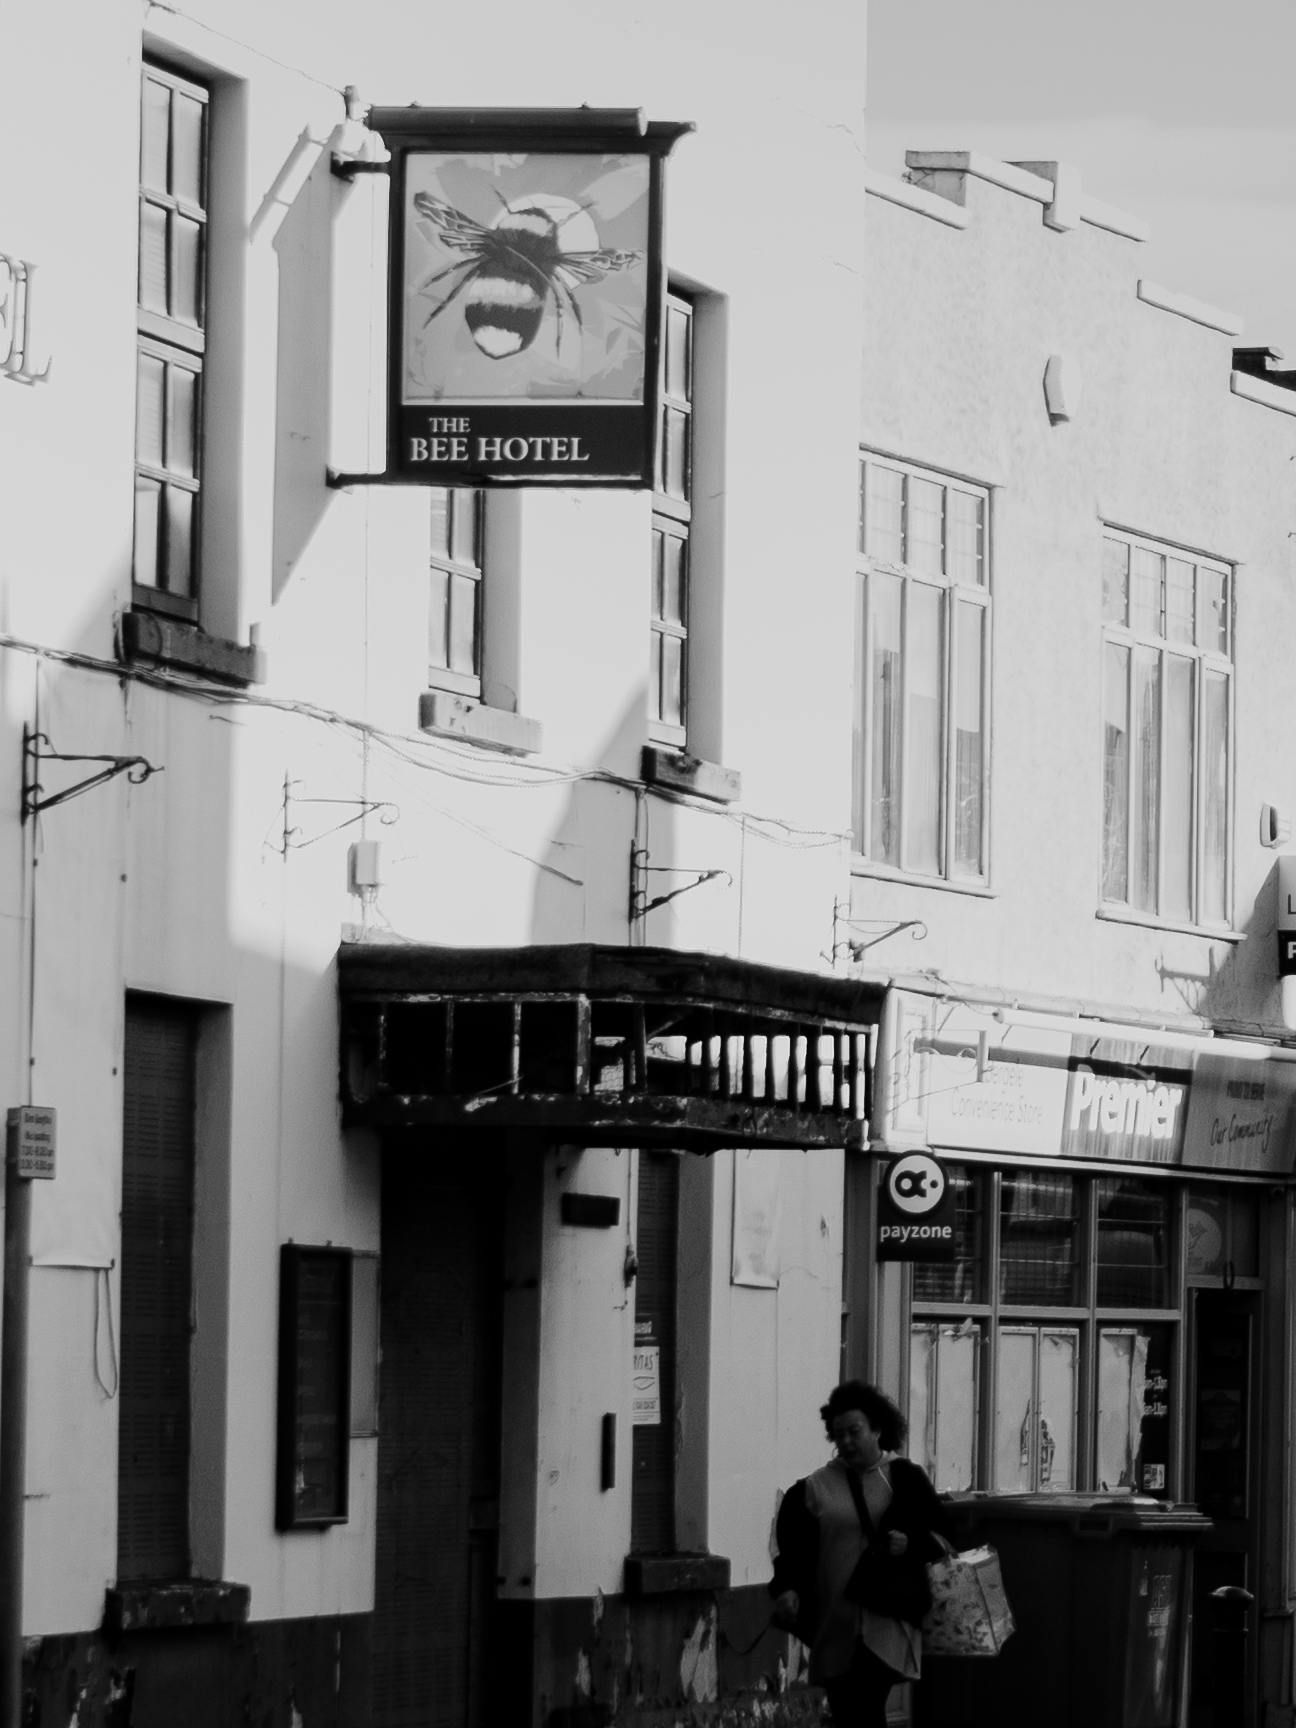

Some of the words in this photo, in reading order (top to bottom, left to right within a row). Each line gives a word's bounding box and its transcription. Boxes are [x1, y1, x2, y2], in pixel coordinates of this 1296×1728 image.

[429, 417, 471, 433] THE
[410, 437, 469, 462] BEE
[477, 436, 590, 462] HOTEL
[1070, 1063, 1183, 1140] Premier
[880, 1225, 952, 1243] payzone
